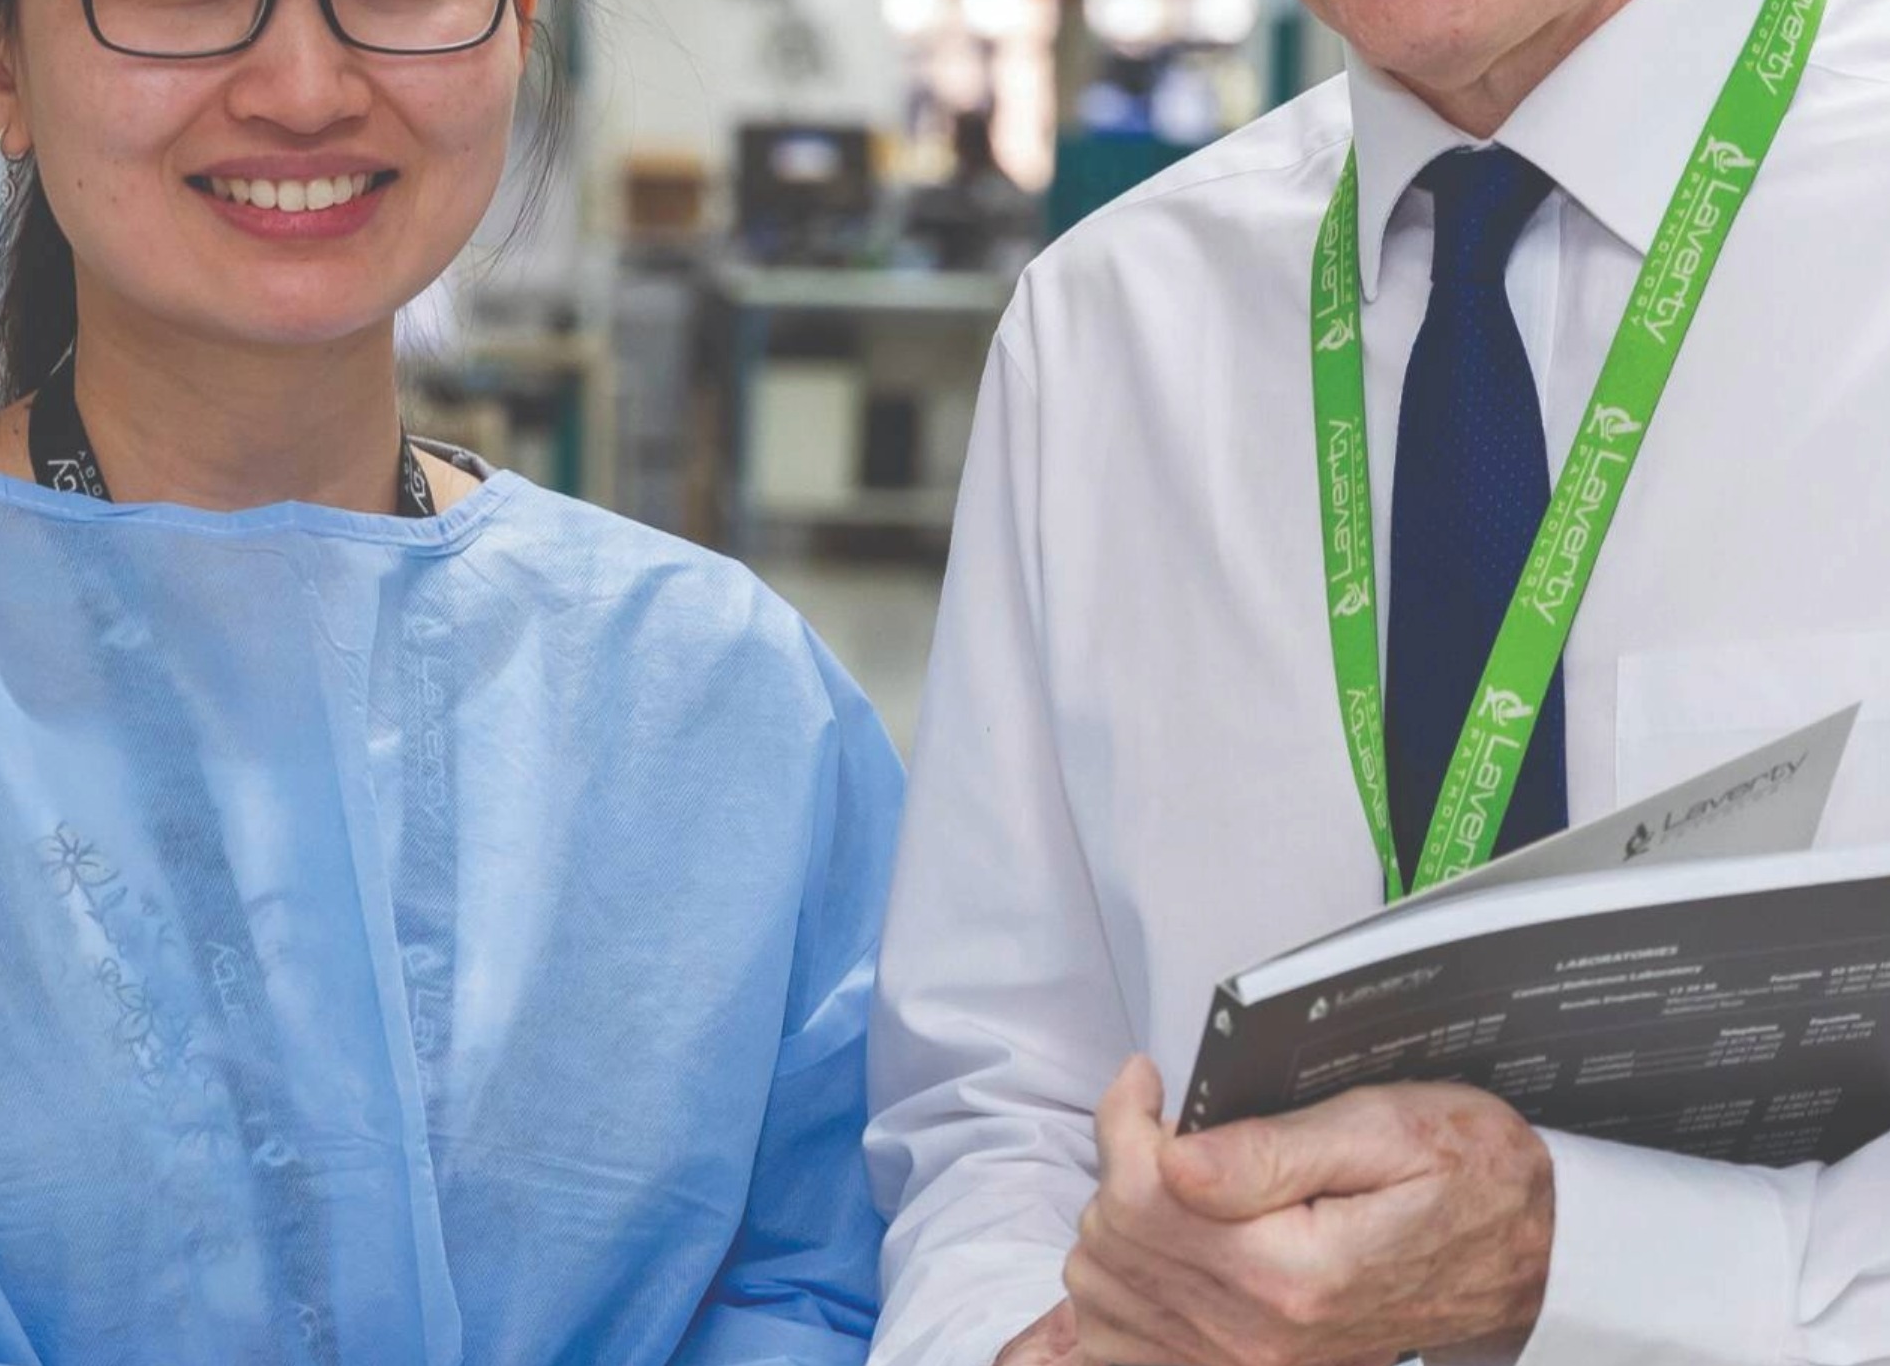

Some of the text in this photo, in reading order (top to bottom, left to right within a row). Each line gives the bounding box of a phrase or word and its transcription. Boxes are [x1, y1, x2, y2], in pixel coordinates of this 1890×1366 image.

[1630, 171, 1702, 327] PATHOLOGY
[1644, 180, 1741, 345] Laverty
[1328, 419, 1354, 582] Laverty
[1520, 443, 1591, 608] PATHOLOGY
[1533, 449, 1627, 627] Laverty
[1347, 688, 1387, 829] averty
[1664, 750, 1809, 832] Laverty
[1556, 946, 1678, 971] LABORATORIES
